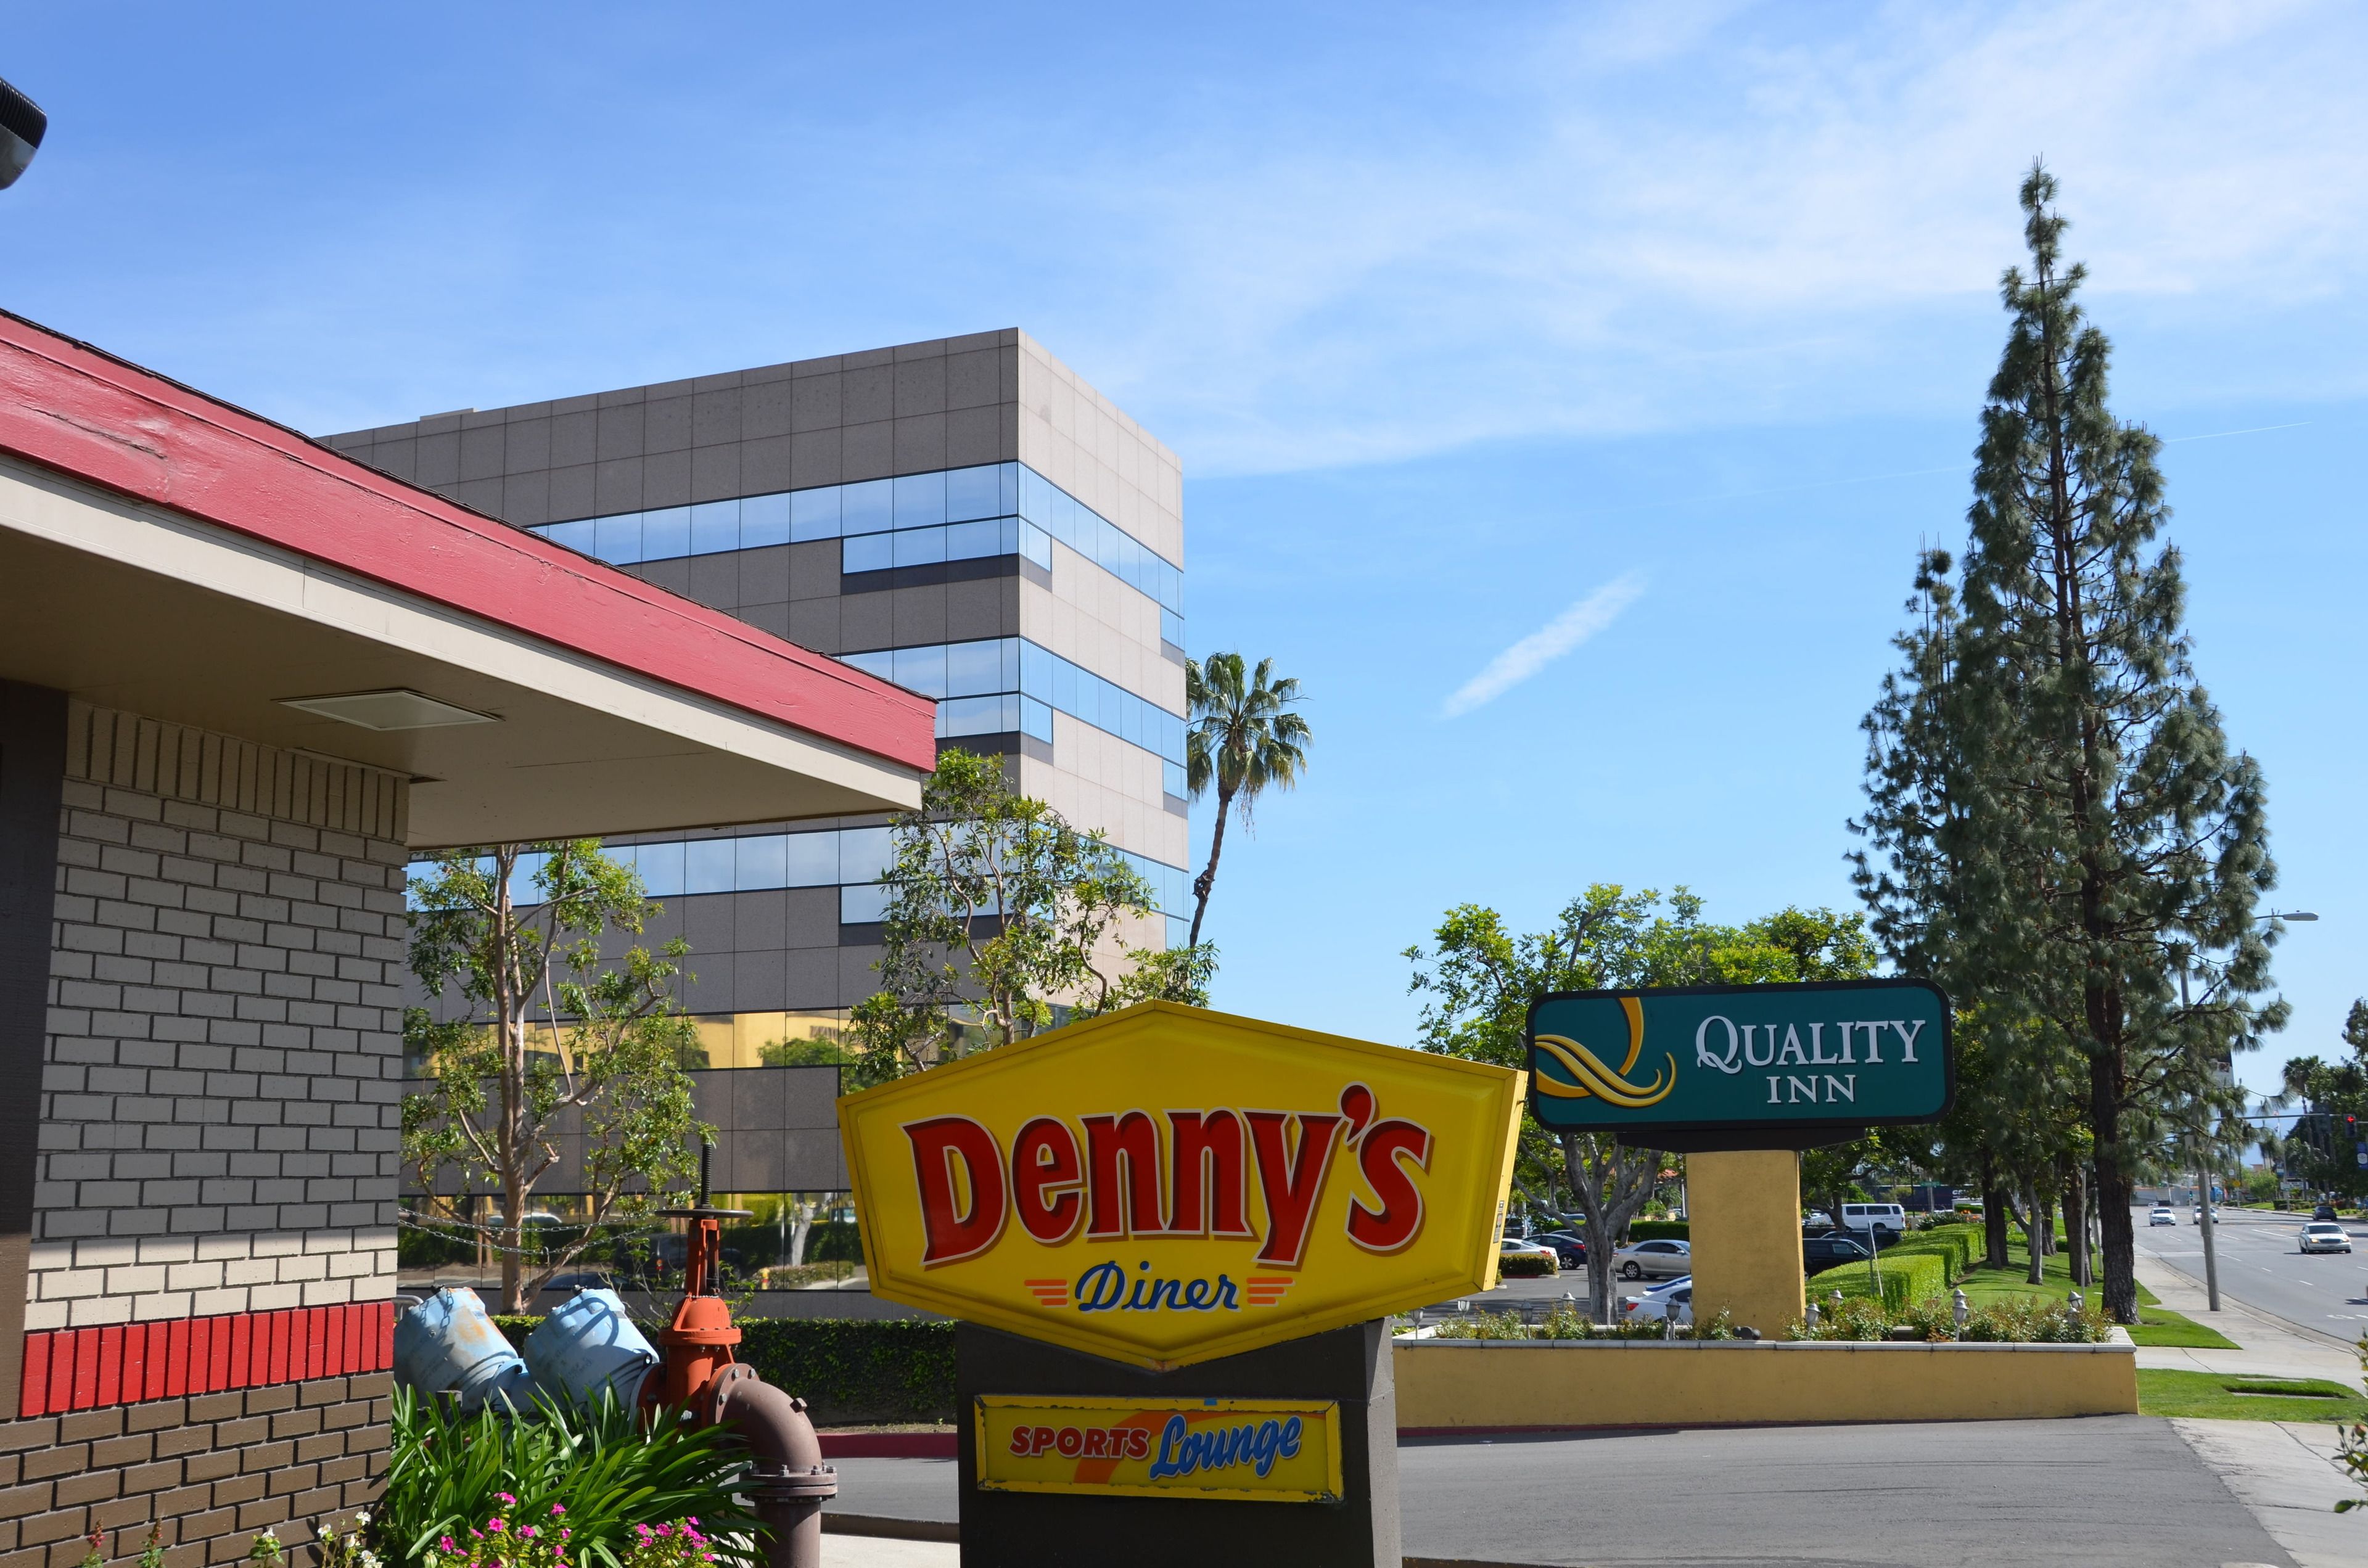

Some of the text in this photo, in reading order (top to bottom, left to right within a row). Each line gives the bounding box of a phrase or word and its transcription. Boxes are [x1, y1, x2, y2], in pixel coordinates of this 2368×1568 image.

[1696, 1015, 1926, 1074] QUALITY
[1766, 1074, 1856, 1104] INN
[898, 1081, 1432, 1268] Denny's
[1075, 1260, 1240, 1311] Diner
[1009, 1413, 1303, 1479] SPORTS Lounge
